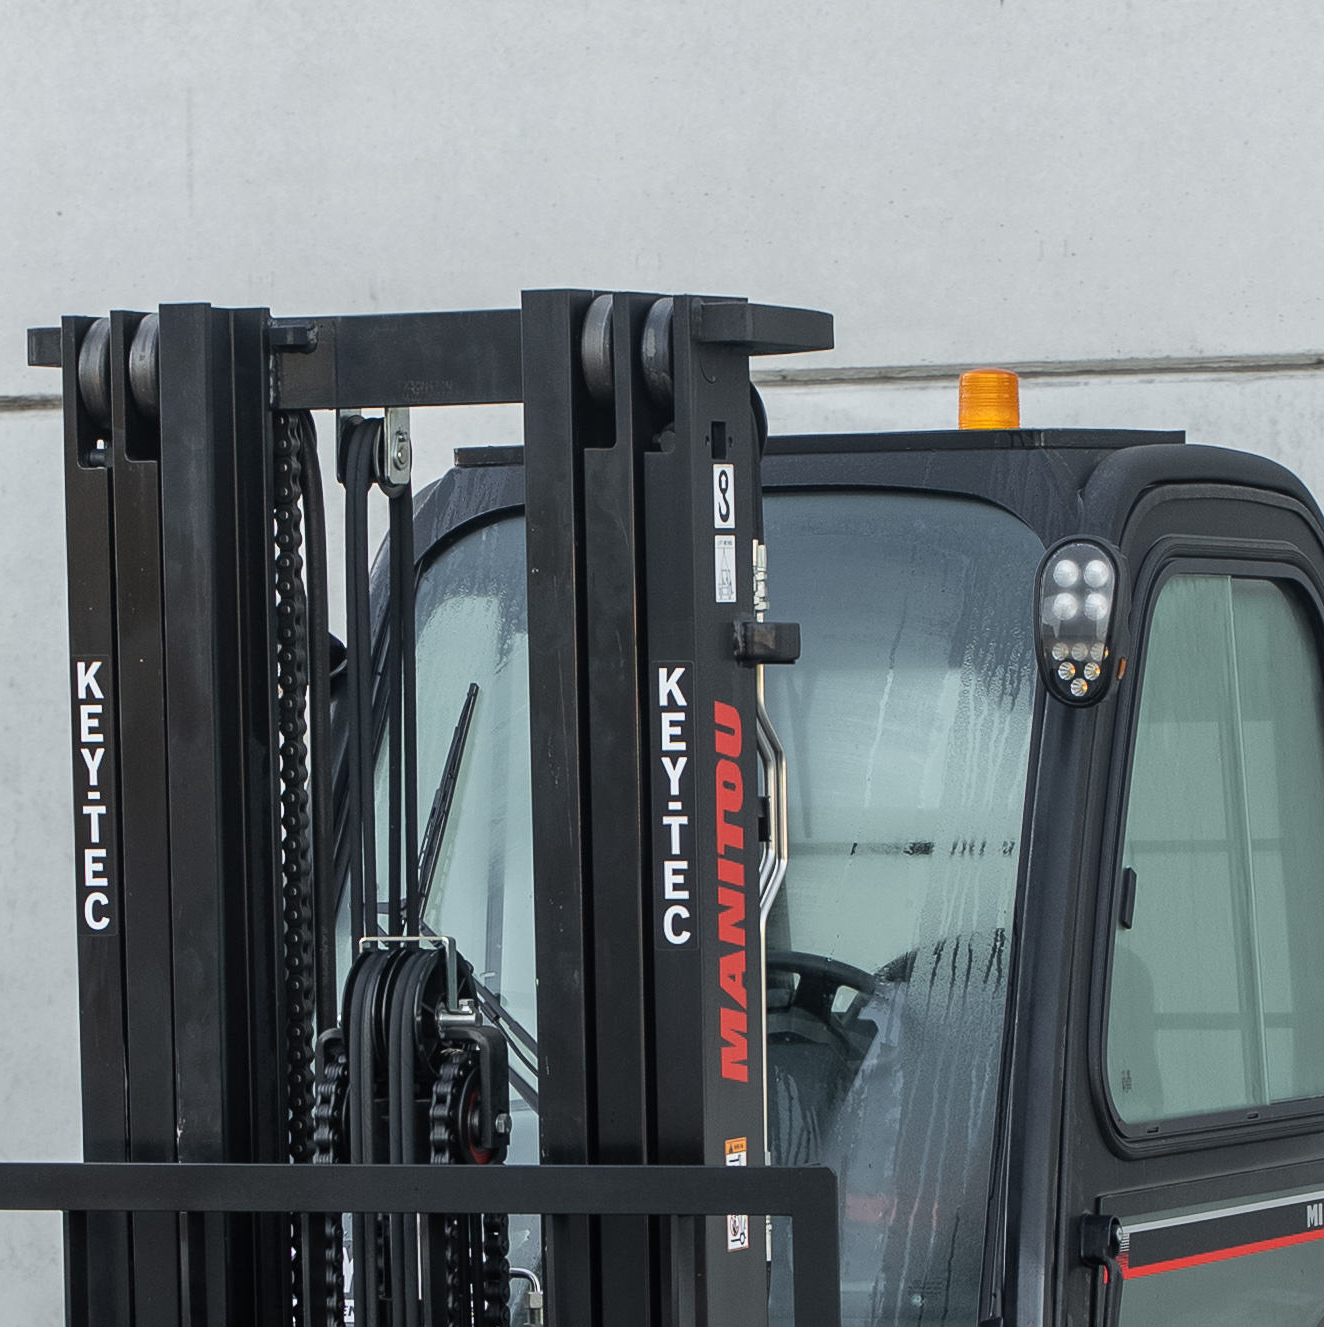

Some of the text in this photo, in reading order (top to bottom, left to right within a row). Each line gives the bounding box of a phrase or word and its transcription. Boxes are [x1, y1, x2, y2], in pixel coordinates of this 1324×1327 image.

[76, 661, 110, 929] KEY-TEC
[658, 667, 691, 945] KEY-TEC
[714, 700, 749, 1083] MANITOU
